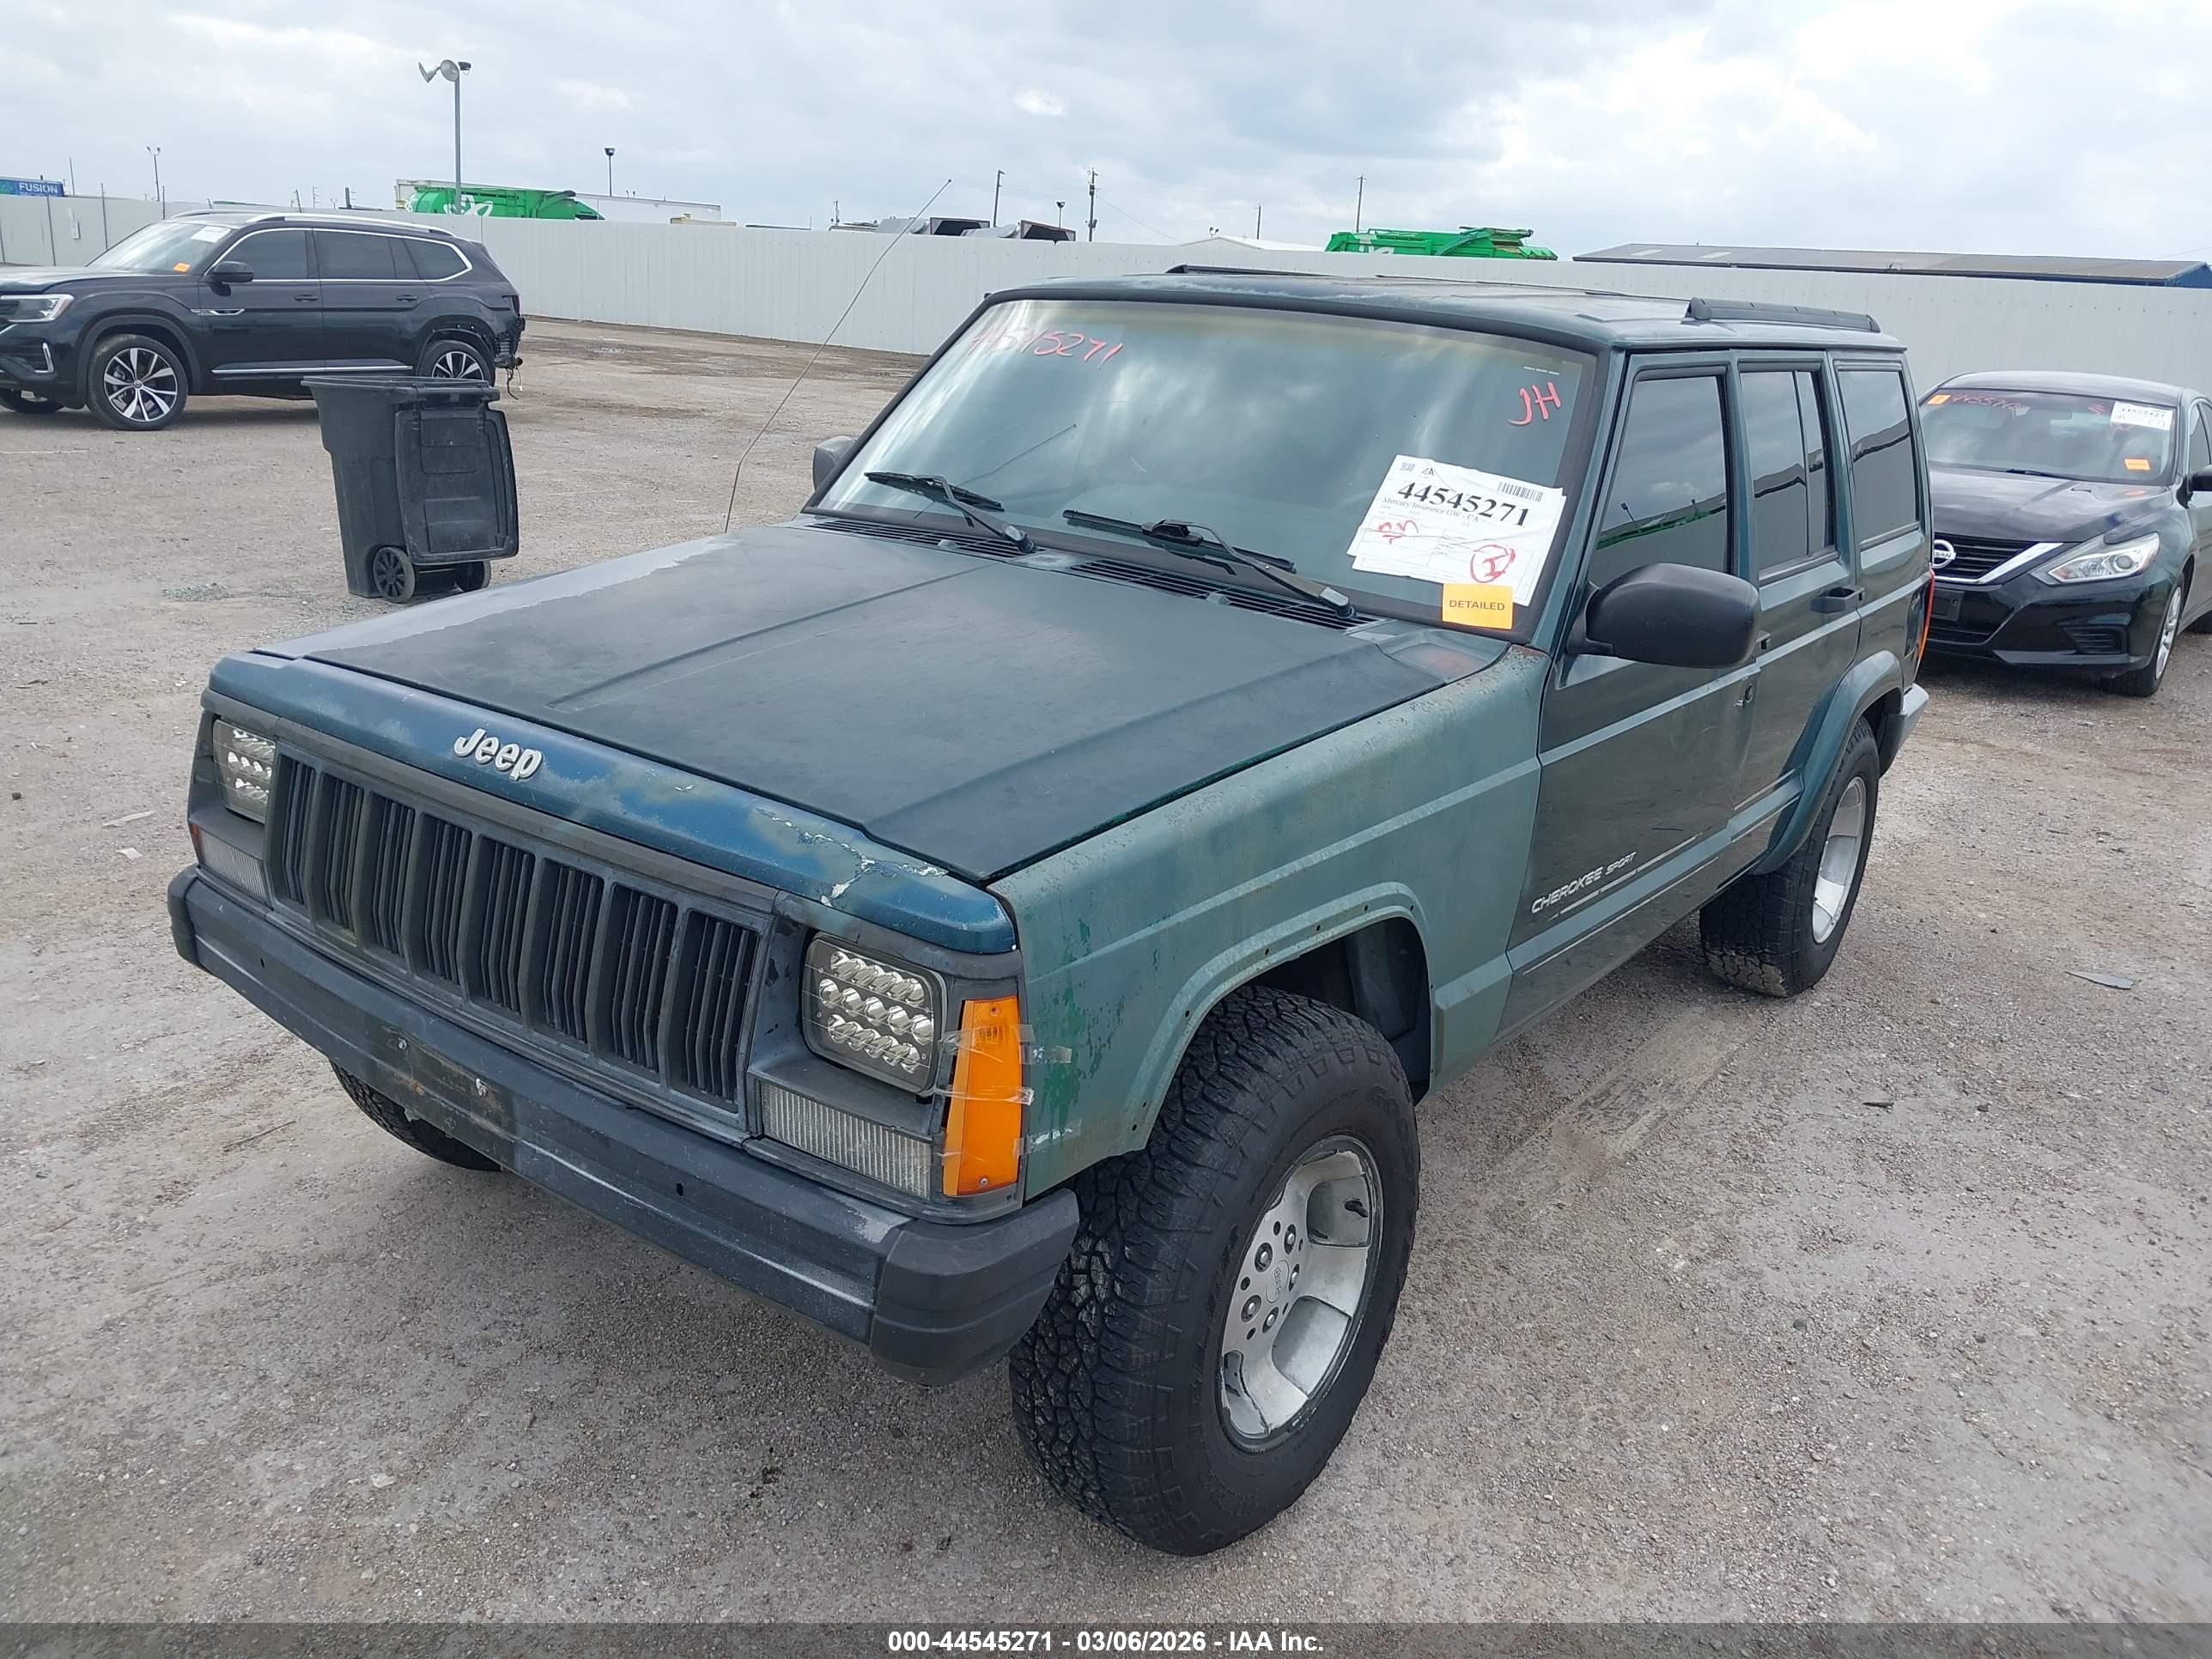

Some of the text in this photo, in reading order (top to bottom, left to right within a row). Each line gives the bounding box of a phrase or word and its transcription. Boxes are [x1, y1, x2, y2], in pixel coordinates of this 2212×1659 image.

[19, 182, 58, 193] FUSION
[1507, 381, 1561, 426] JH
[1382, 497, 1410, 509] Mercury
[1411, 501, 1445, 515] Insurance
[1397, 482, 1530, 526] 44545271
[1449, 599, 1505, 611] DETAILED
[453, 728, 543, 781] Jeep
[1531, 851, 1638, 914] CHEROKEE SPORT
